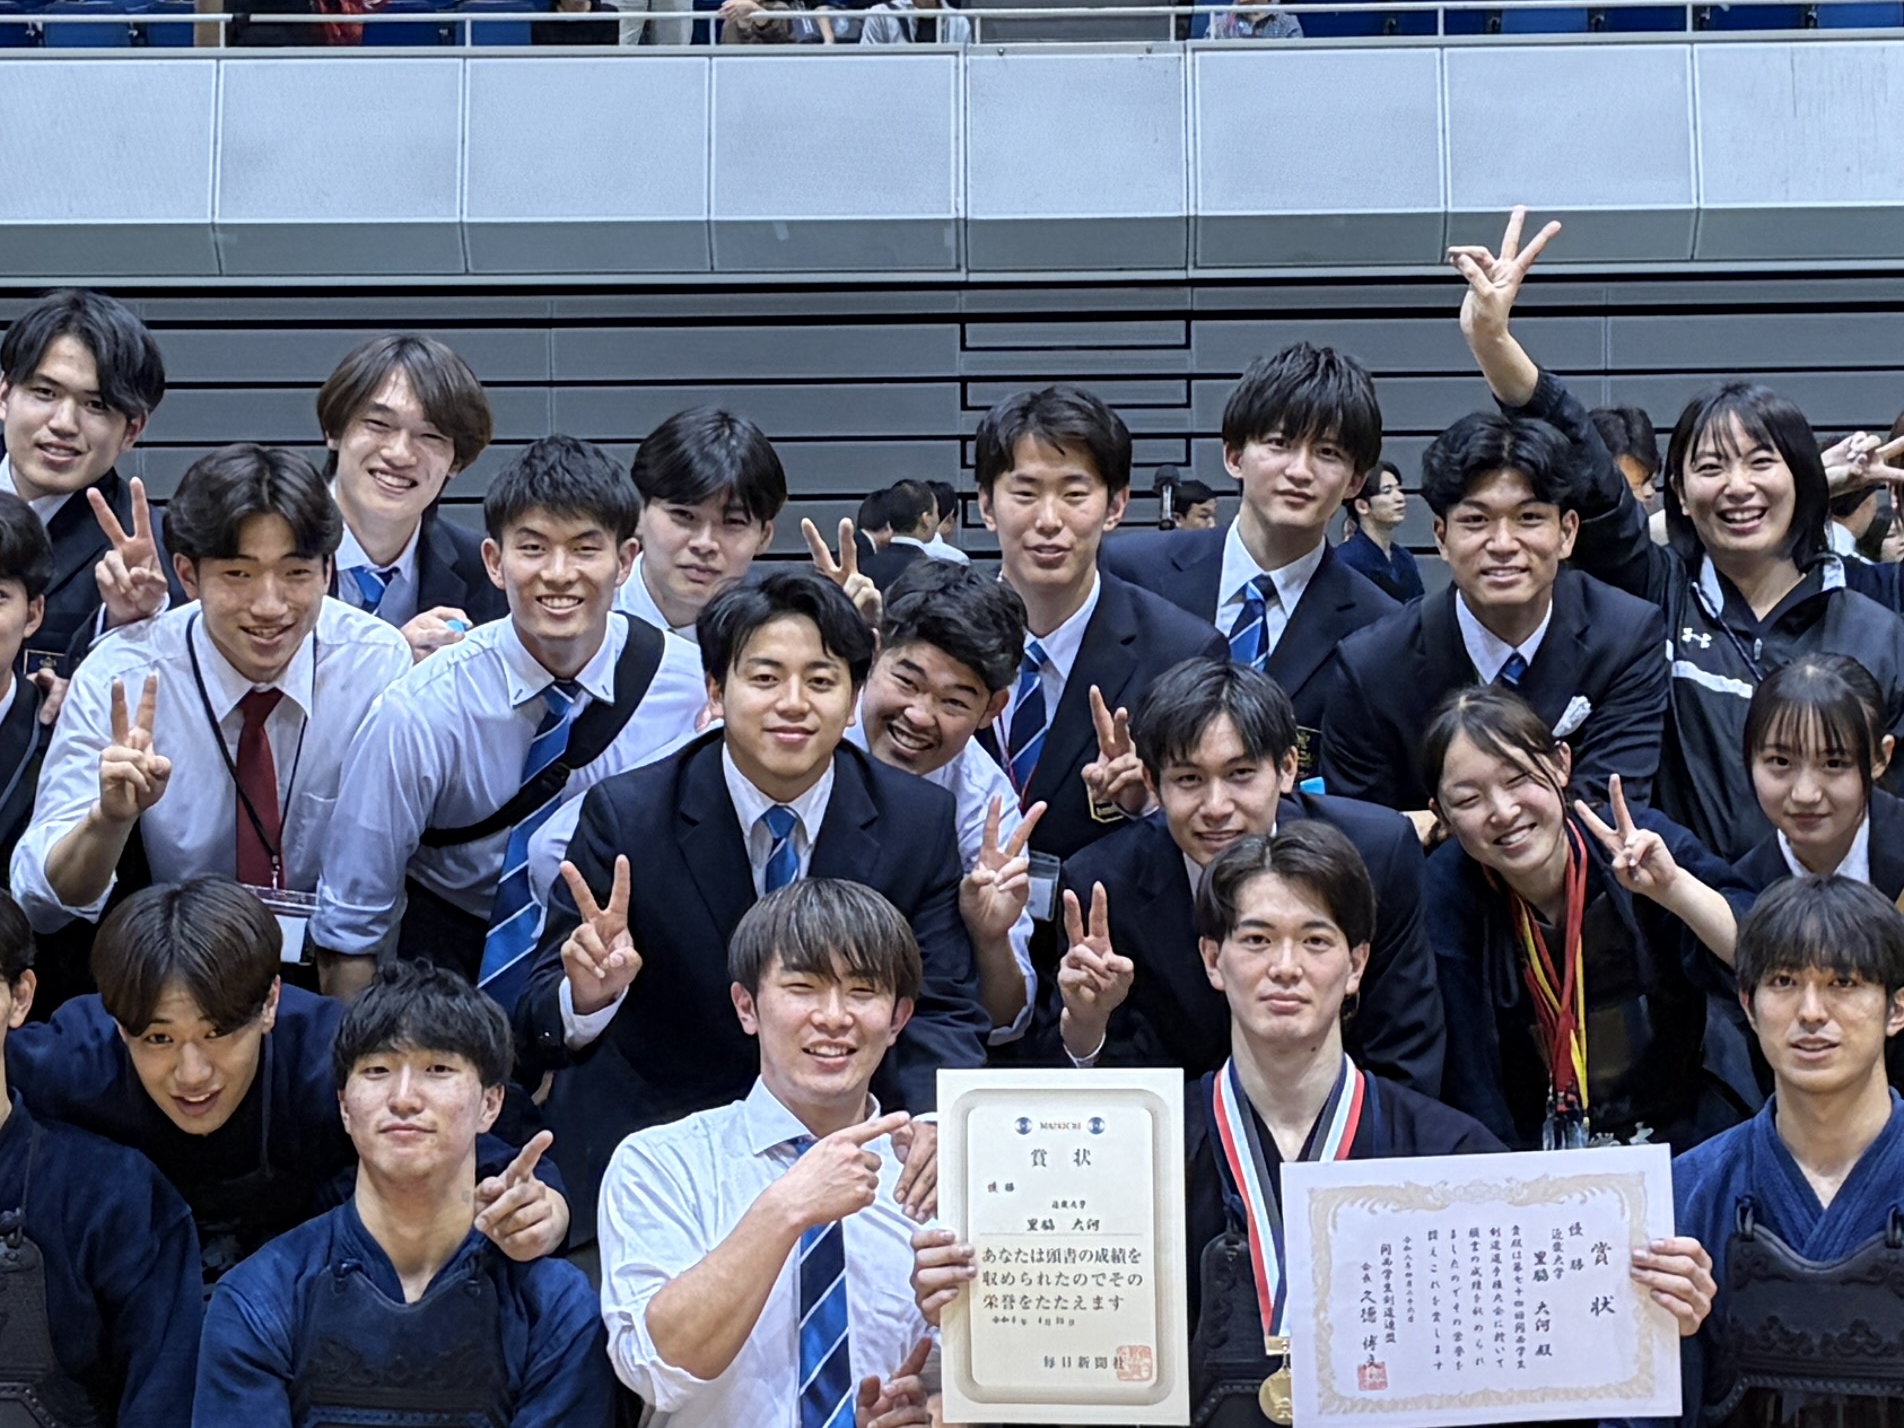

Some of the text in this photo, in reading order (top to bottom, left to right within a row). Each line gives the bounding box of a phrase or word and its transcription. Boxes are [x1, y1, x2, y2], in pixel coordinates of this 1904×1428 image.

[1030, 1148, 1092, 1168] 賞状
[982, 1247, 1142, 1264] あなたは頭書の成績を
[982, 1270, 1143, 1287] 収められたのでその
[1590, 1241, 1615, 1317] 賞状
[983, 1293, 1124, 1311] 栄誉をたたえます
